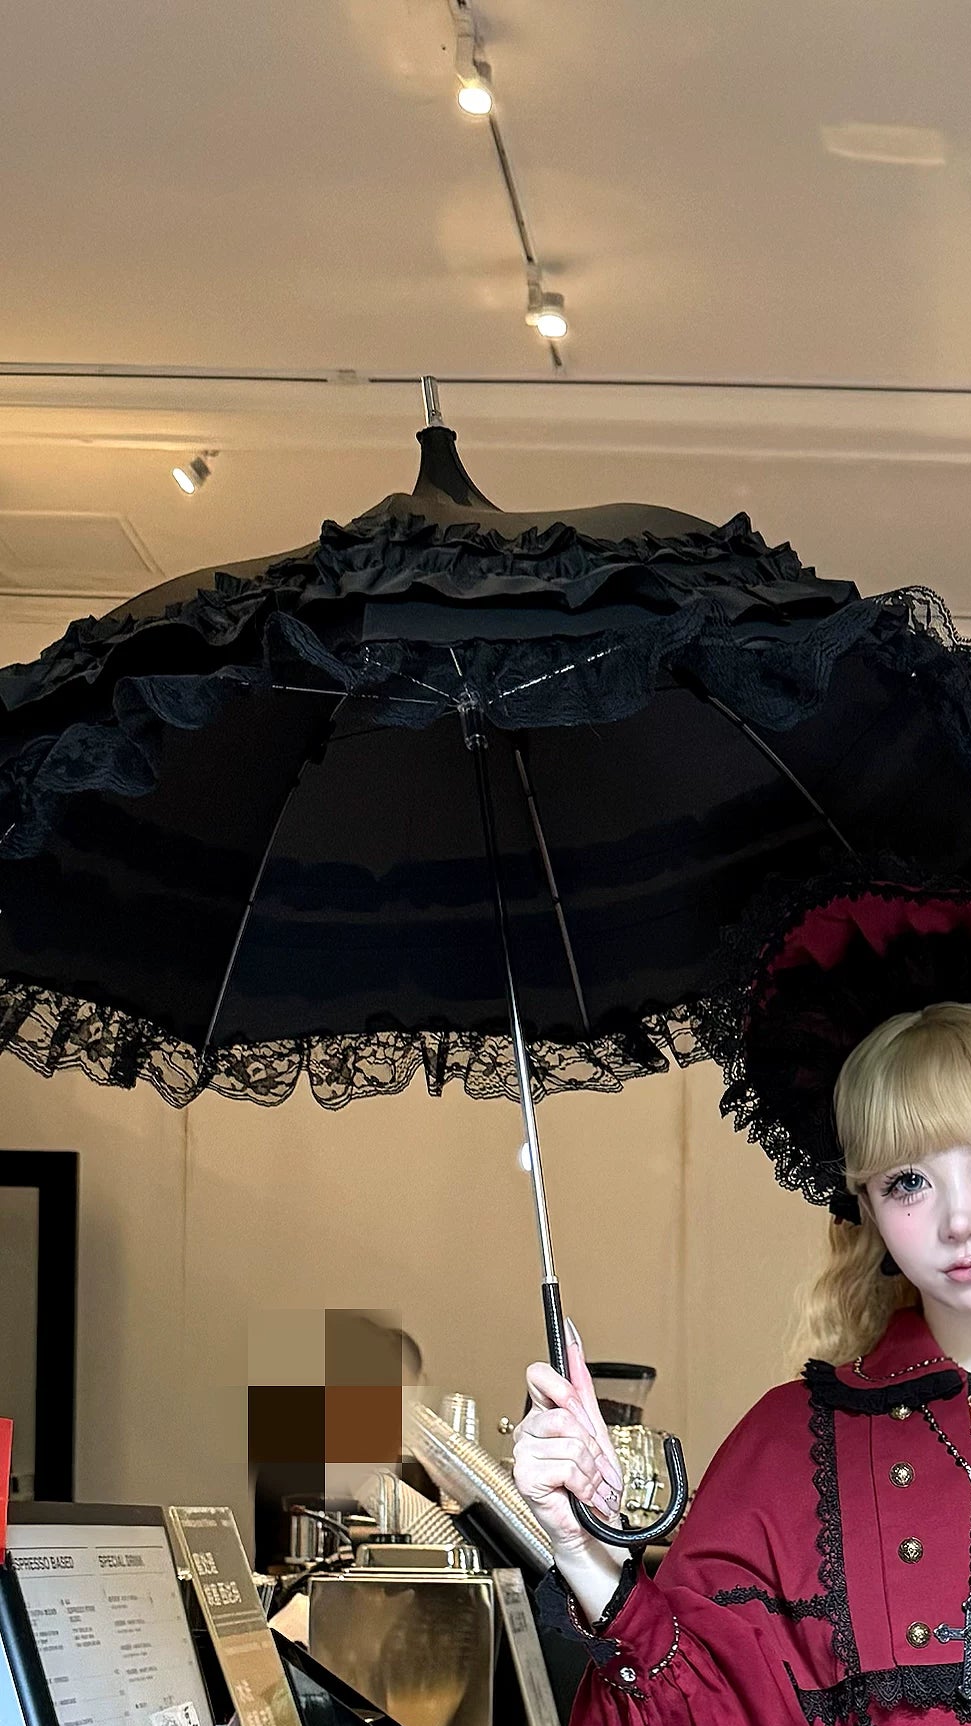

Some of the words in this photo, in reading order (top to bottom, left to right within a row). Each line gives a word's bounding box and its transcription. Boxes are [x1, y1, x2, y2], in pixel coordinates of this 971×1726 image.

[12, 1556, 50, 1571] SPRESSO
[51, 1556, 74, 1569] BASED
[98, 1555, 125, 1568] SPECIAL
